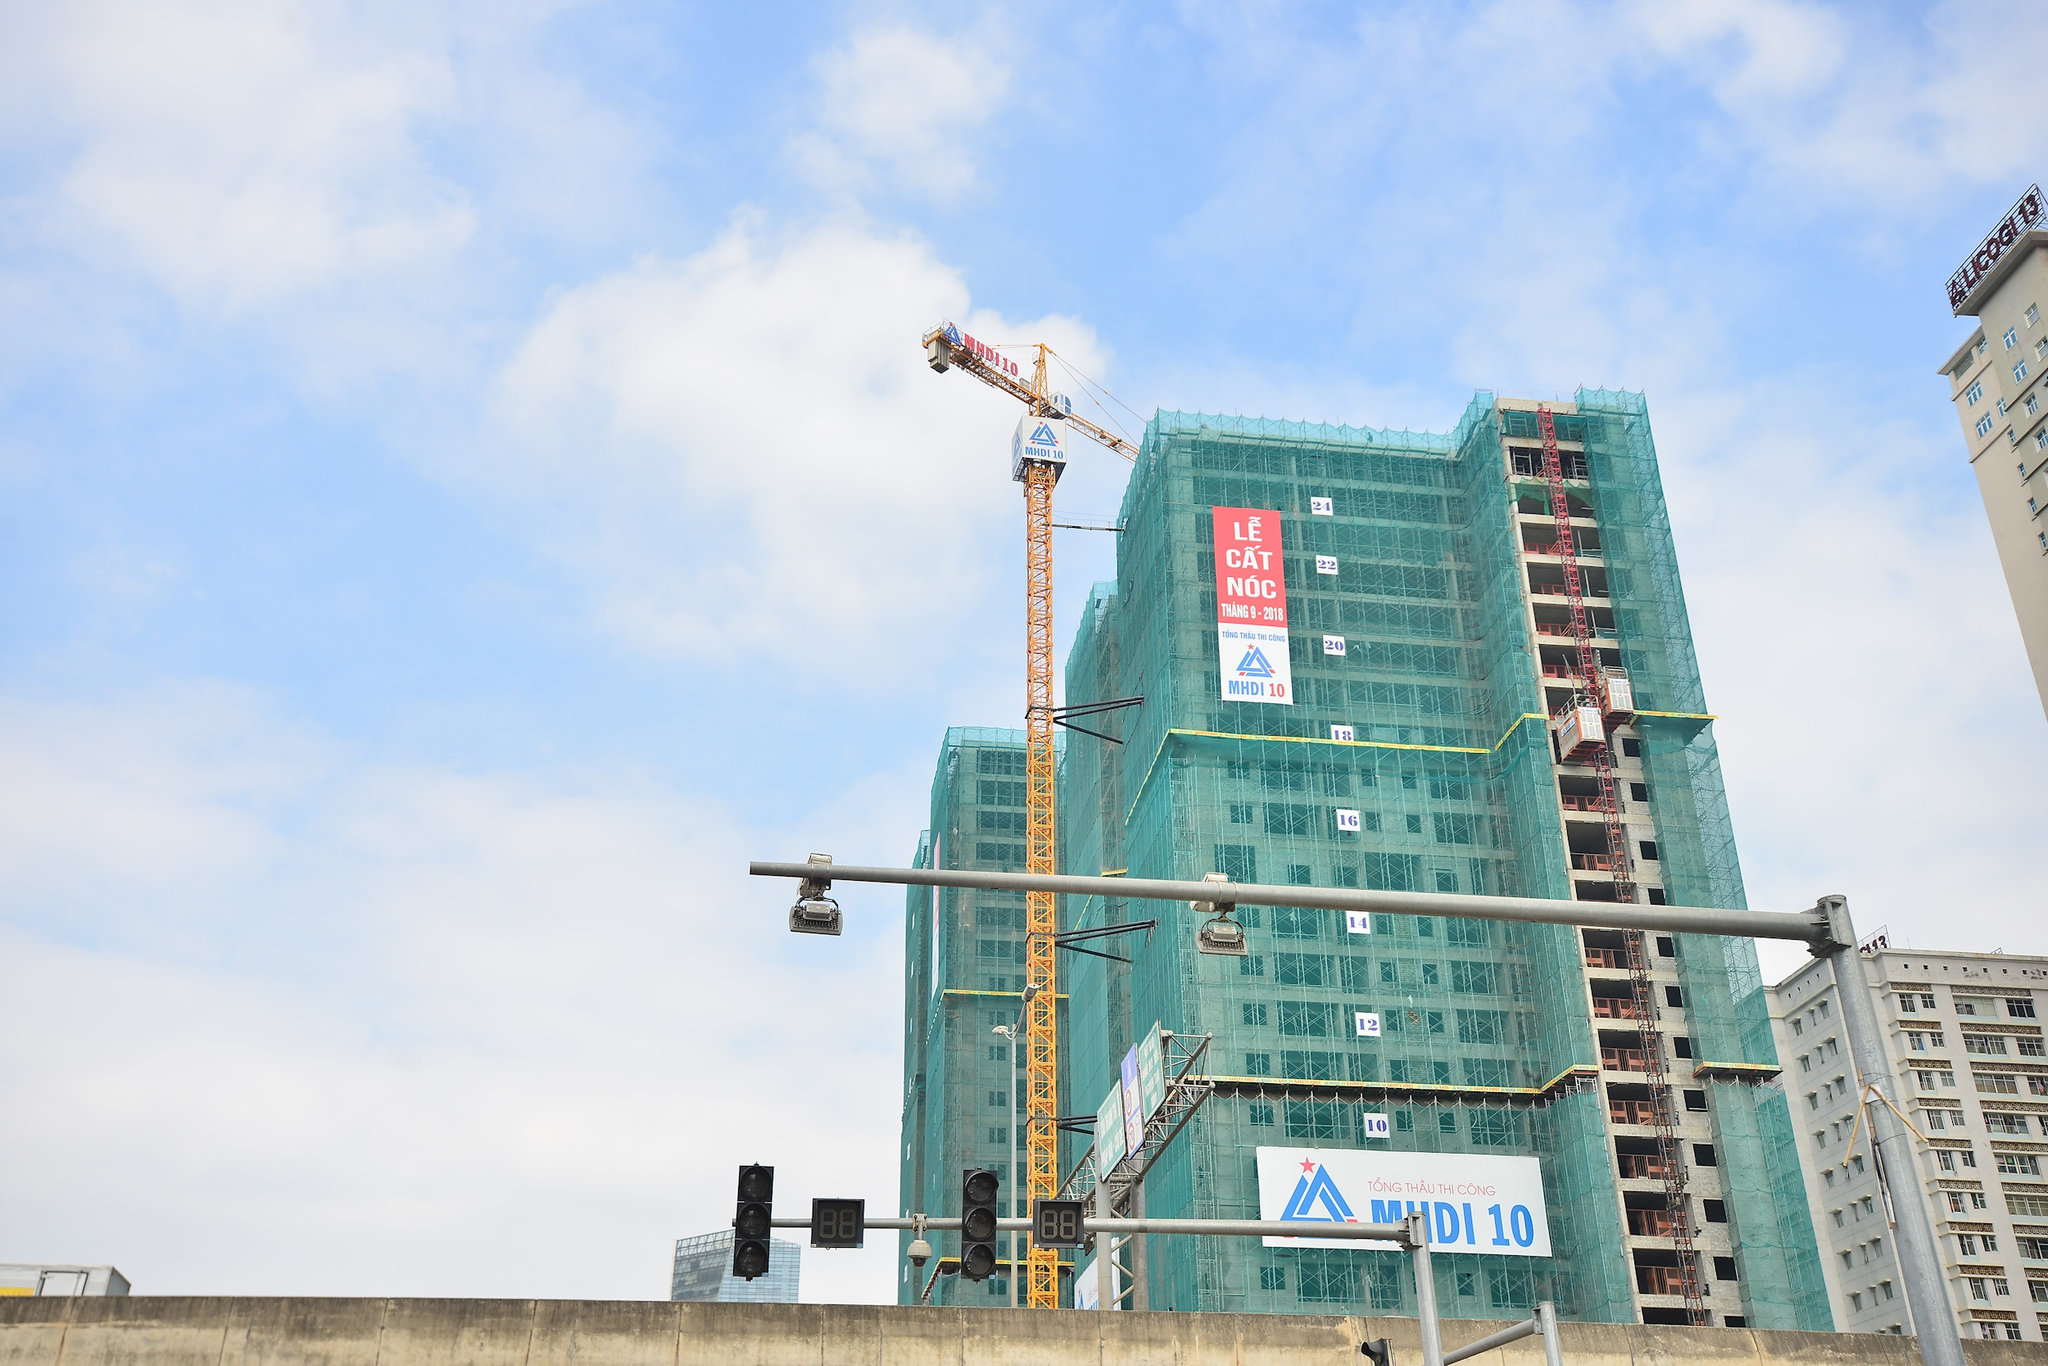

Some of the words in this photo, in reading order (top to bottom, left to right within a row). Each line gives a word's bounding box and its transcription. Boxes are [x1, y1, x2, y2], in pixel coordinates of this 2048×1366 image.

[1962, 216, 2019, 289] LICOGI
[2018, 194, 2039, 224] 13
[964, 333, 1000, 367] MHDI
[1003, 357, 1019, 377] 10
[1025, 446, 1051, 458] MHDI
[1053, 450, 1064, 460] 10
[1312, 500, 1331, 512] 24
[1233, 516, 1263, 542] LỄ
[1226, 545, 1273, 571] CẤT
[1318, 559, 1337, 571] 22
[1226, 575, 1277, 600] NÓC
[1221, 602, 1249, 619] THÁNG
[1250, 604, 1256, 619] 9
[1263, 606, 1284, 622] 2018
[1257, 633, 1268, 641] THI
[1325, 640, 1344, 652] 20
[1228, 680, 1265, 697] MHDI
[1269, 682, 1285, 698] 10
[1334, 730, 1352, 741] 18
[1340, 813, 1358, 827] 16
[1349, 916, 1368, 929] 14
[1358, 1018, 1379, 1031] 12
[1367, 1119, 1387, 1132] 10
[1368, 1177, 1403, 1193] TỔNG
[1405, 1179, 1435, 1195] THẦU
[1437, 1184, 1454, 1195] THI
[1457, 1183, 1496, 1197] CÔNG
[1488, 1203, 1534, 1248] 10
